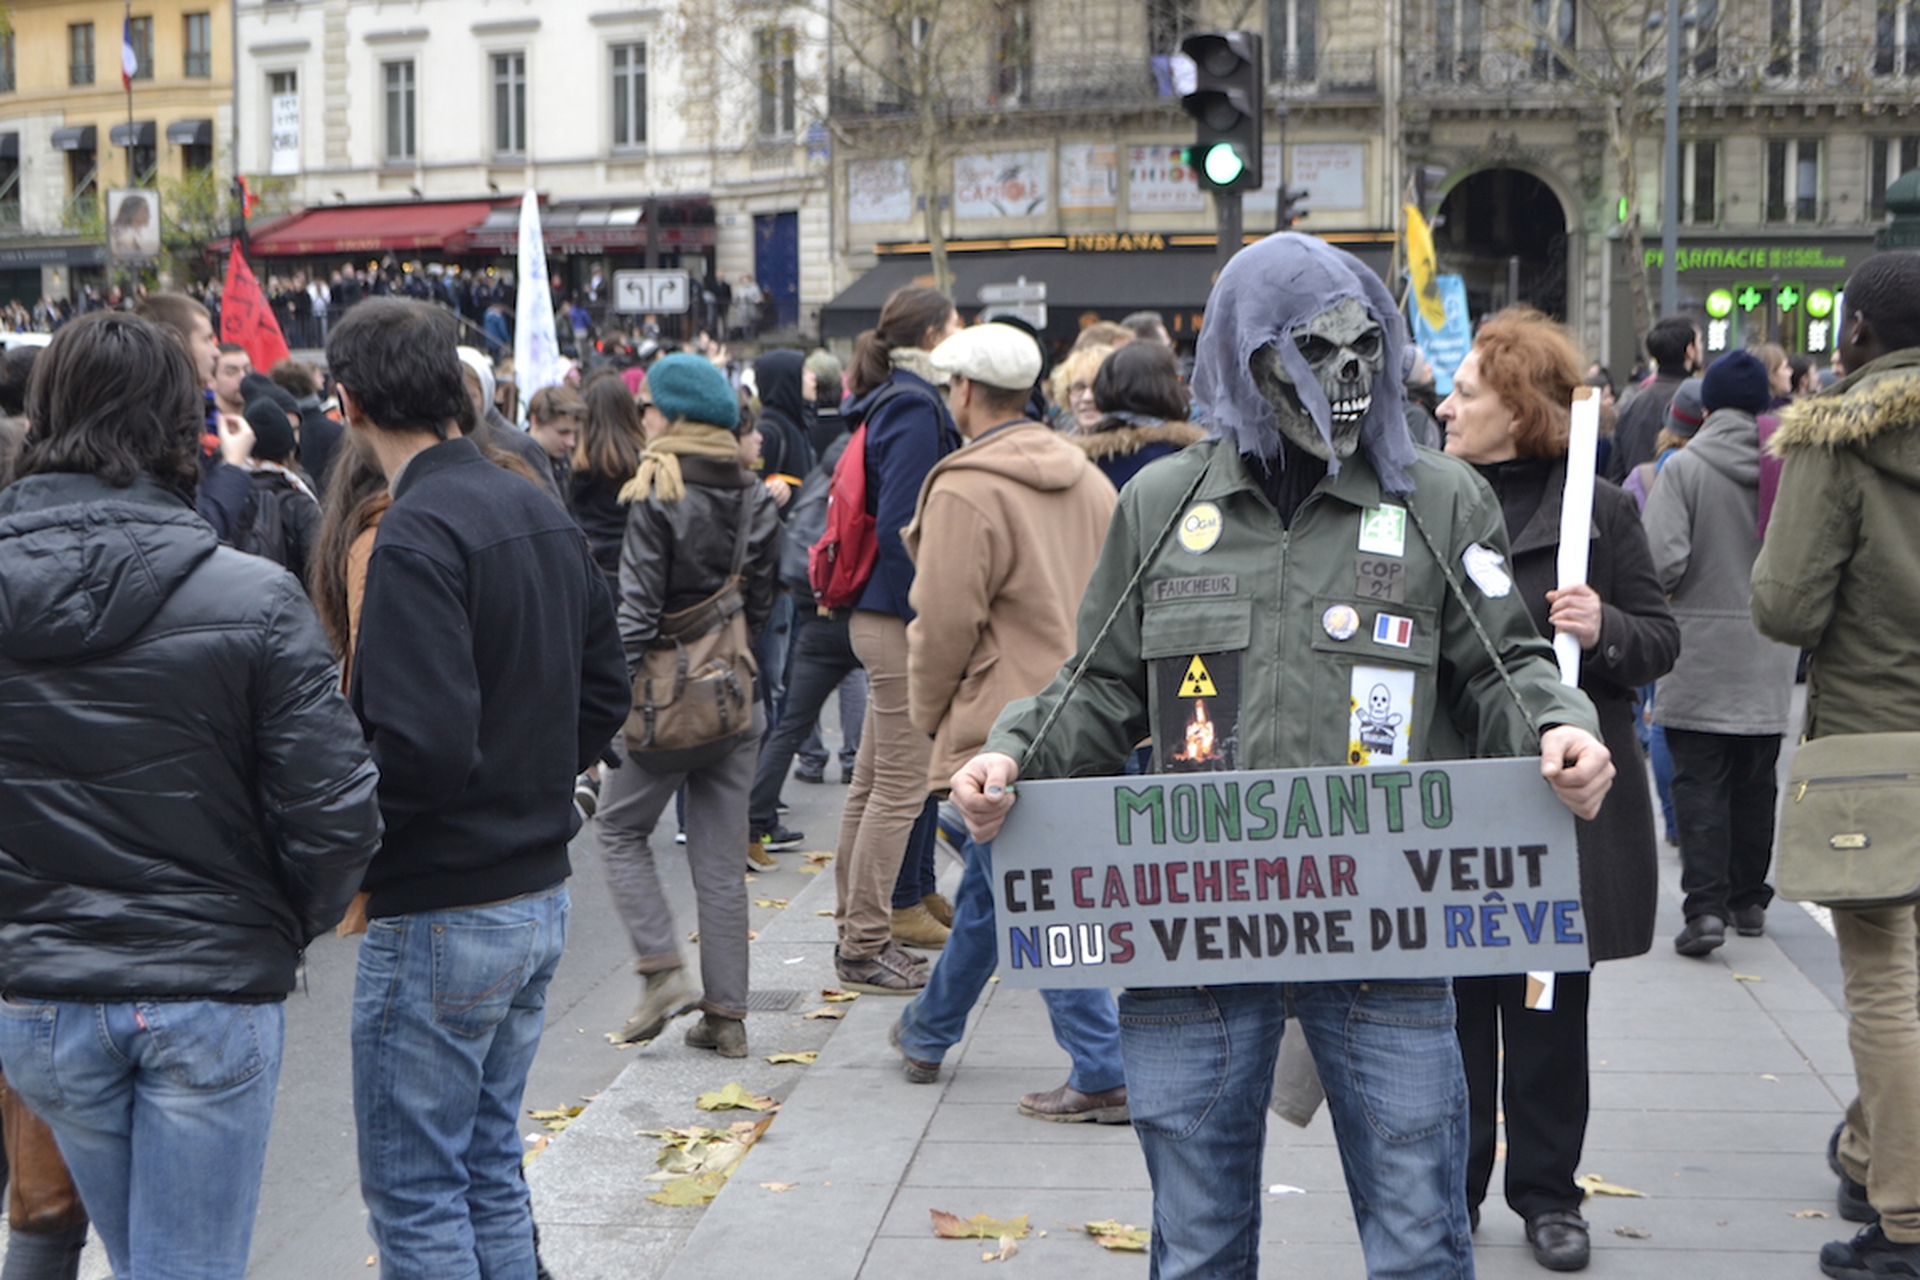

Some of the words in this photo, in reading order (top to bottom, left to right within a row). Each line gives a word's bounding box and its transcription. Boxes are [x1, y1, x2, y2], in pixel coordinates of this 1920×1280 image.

[1067, 232, 1165, 251] INDIANA
[1360, 560, 1402, 580] COP
[1157, 576, 1231, 598] FAUCHEUR
[1370, 580, 1393, 599] 21
[1114, 769, 1453, 846] MONSANTO
[1004, 868, 1056, 914] CE
[1071, 854, 1359, 909] CAUCHEMAR
[1402, 844, 1548, 893] VEUT
[1009, 921, 1136, 969] NOUS
[1149, 908, 1354, 961] VENDRE
[1369, 906, 1428, 952] DU
[1444, 891, 1584, 949] RÊVE
